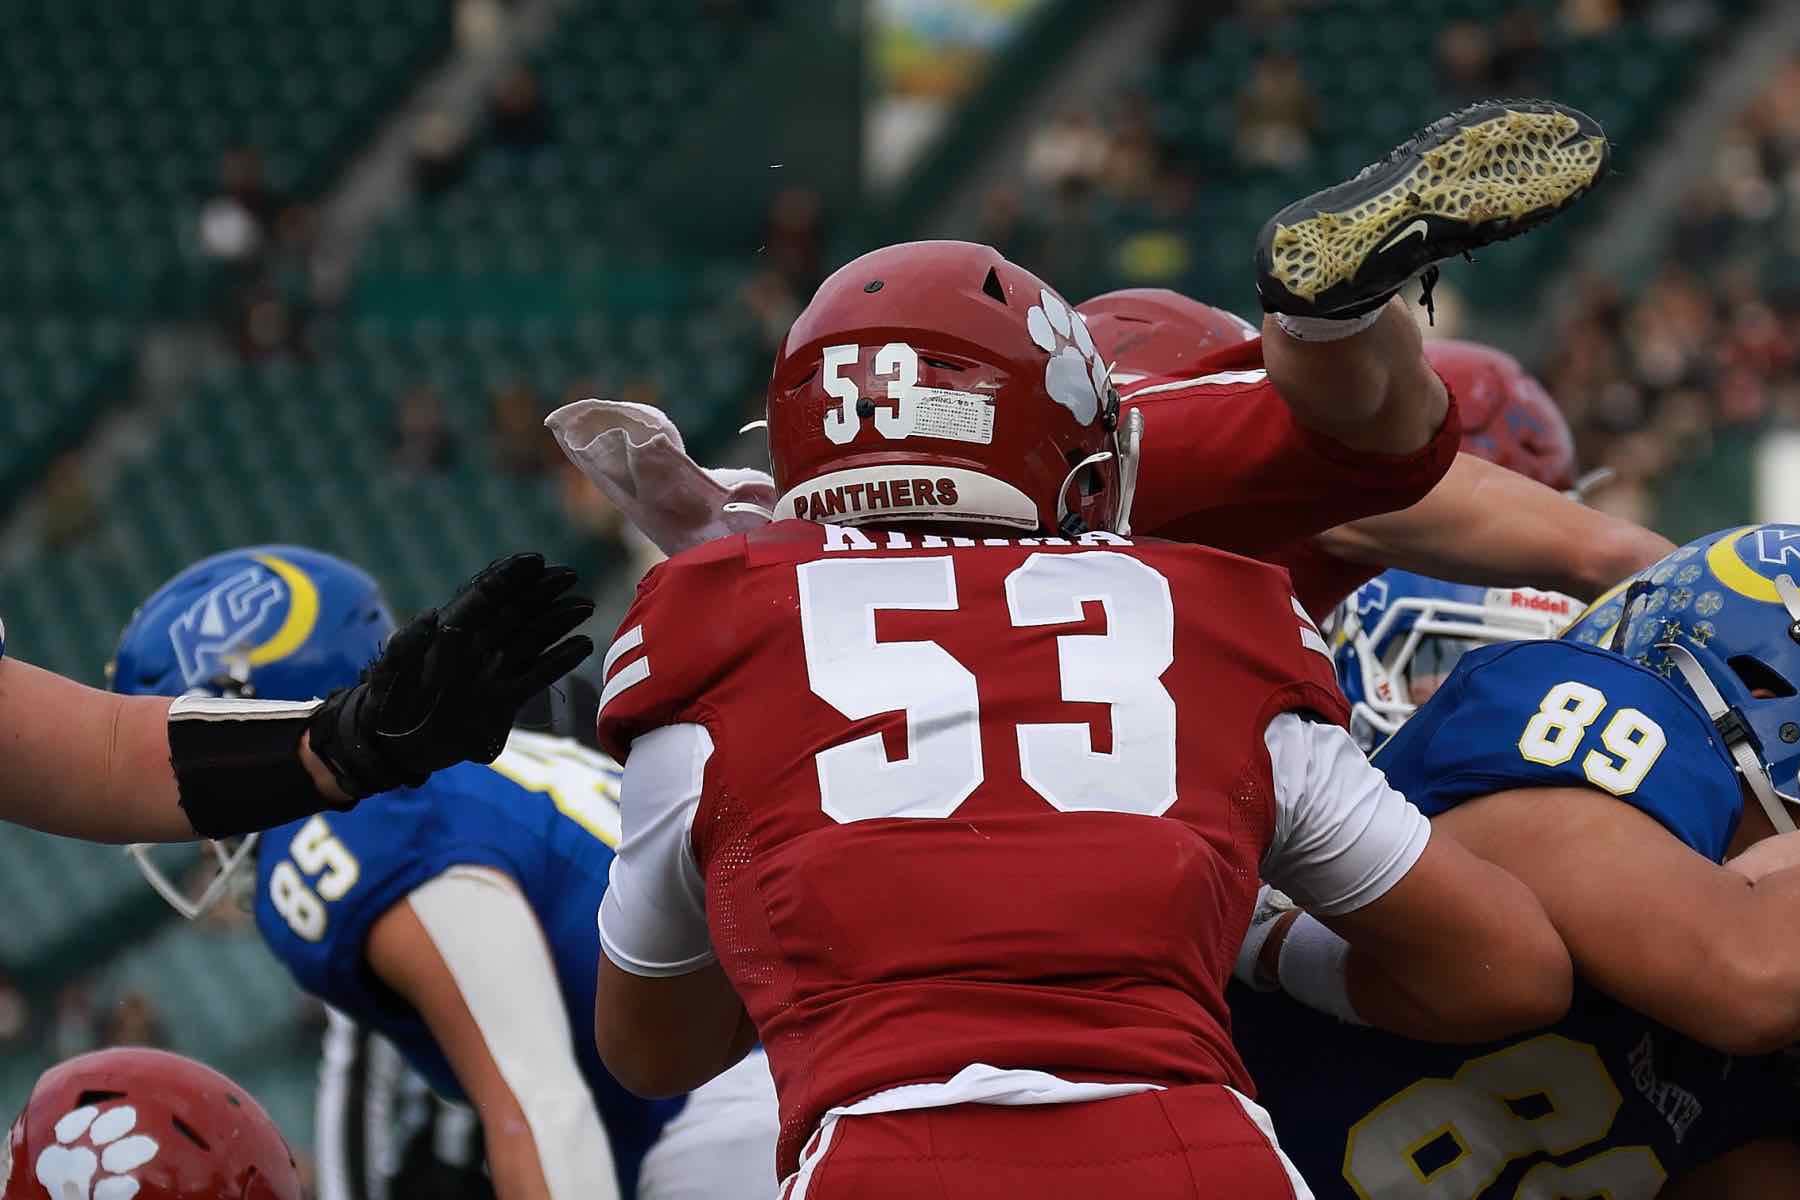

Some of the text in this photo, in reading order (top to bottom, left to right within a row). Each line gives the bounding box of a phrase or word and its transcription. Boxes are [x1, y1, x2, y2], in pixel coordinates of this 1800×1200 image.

[822, 343, 919, 446] 53
[793, 477, 959, 521] PANTHERS
[1511, 591, 1570, 615] Riddell
[797, 551, 1179, 825] 53
[1517, 679, 1667, 796] 89
[268, 815, 361, 943] 85
